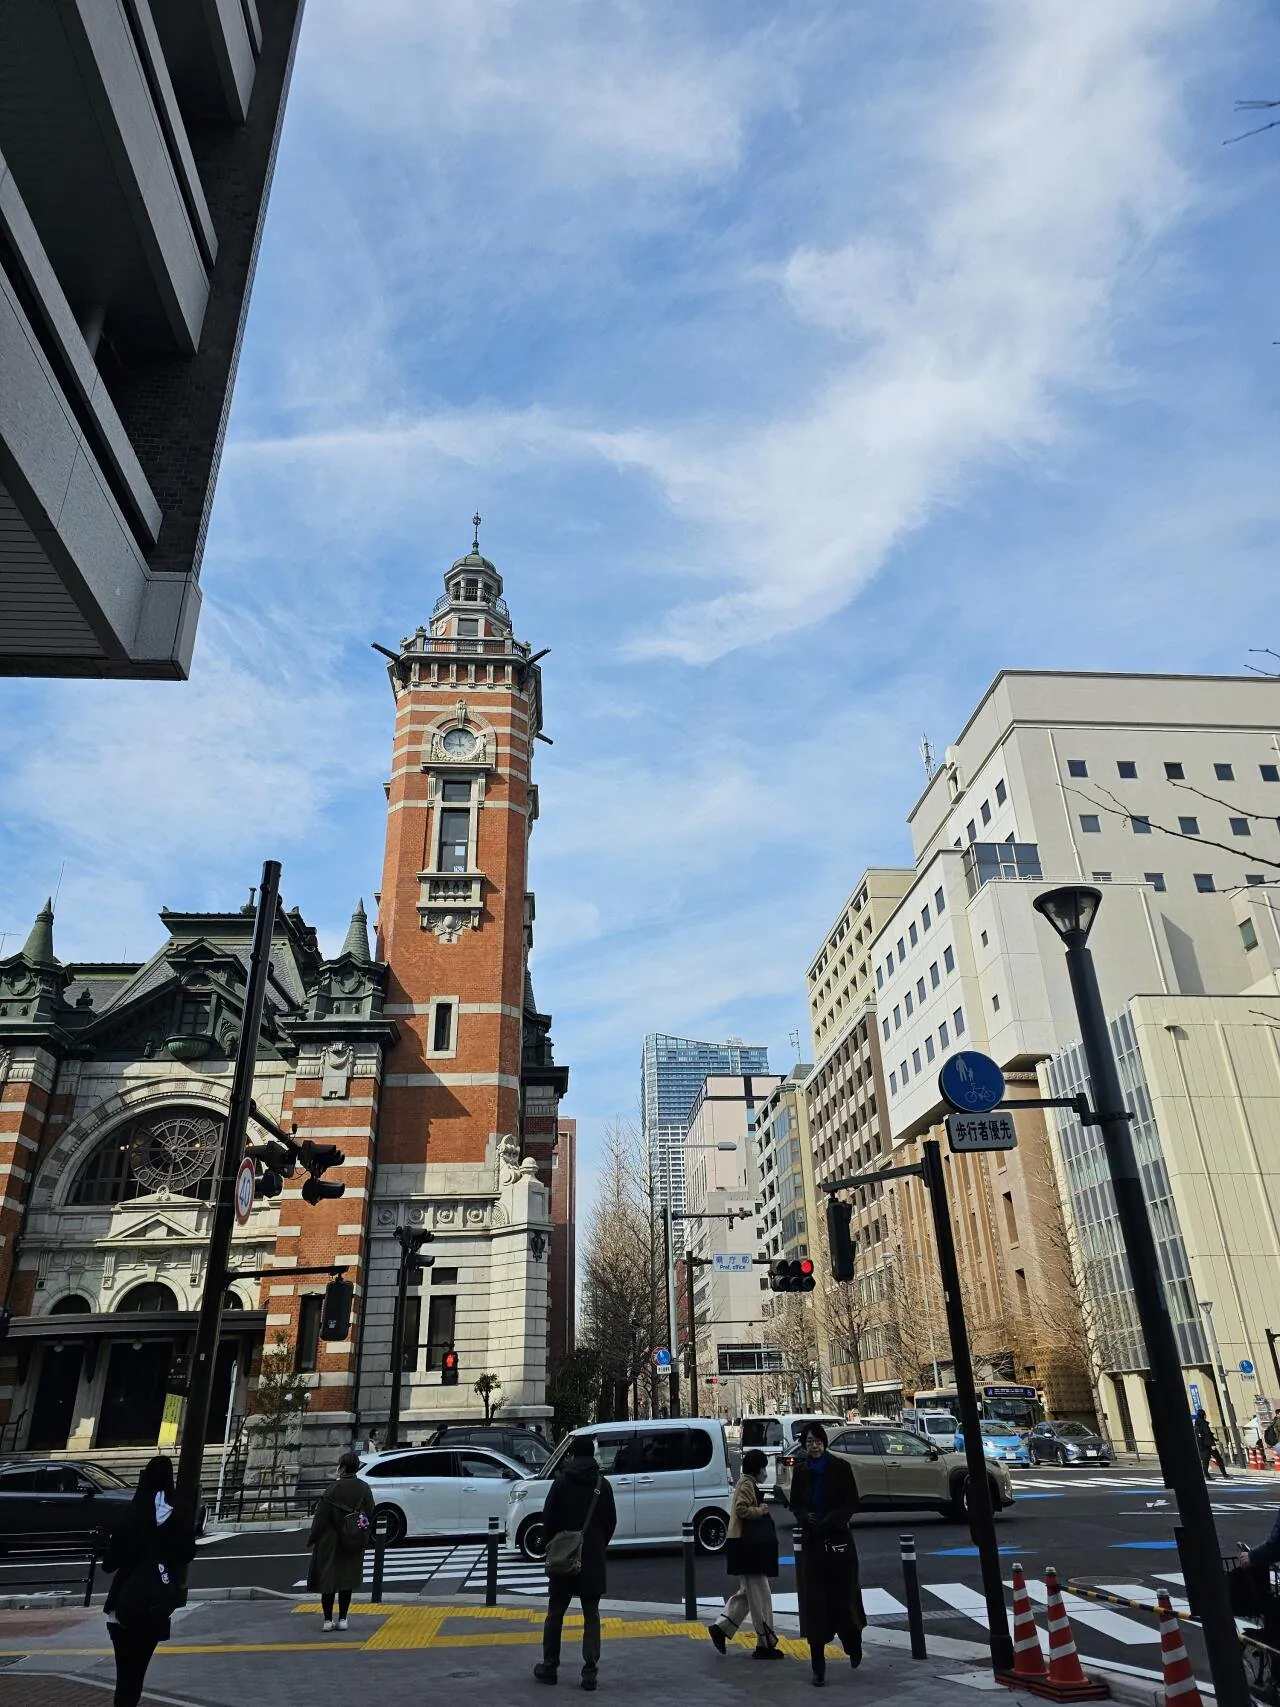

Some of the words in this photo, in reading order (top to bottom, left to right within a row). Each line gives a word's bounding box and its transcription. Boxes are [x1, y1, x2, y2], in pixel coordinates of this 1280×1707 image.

[956, 1120, 1012, 1142] 歩行者優先
[239, 1176, 251, 1208] 40
